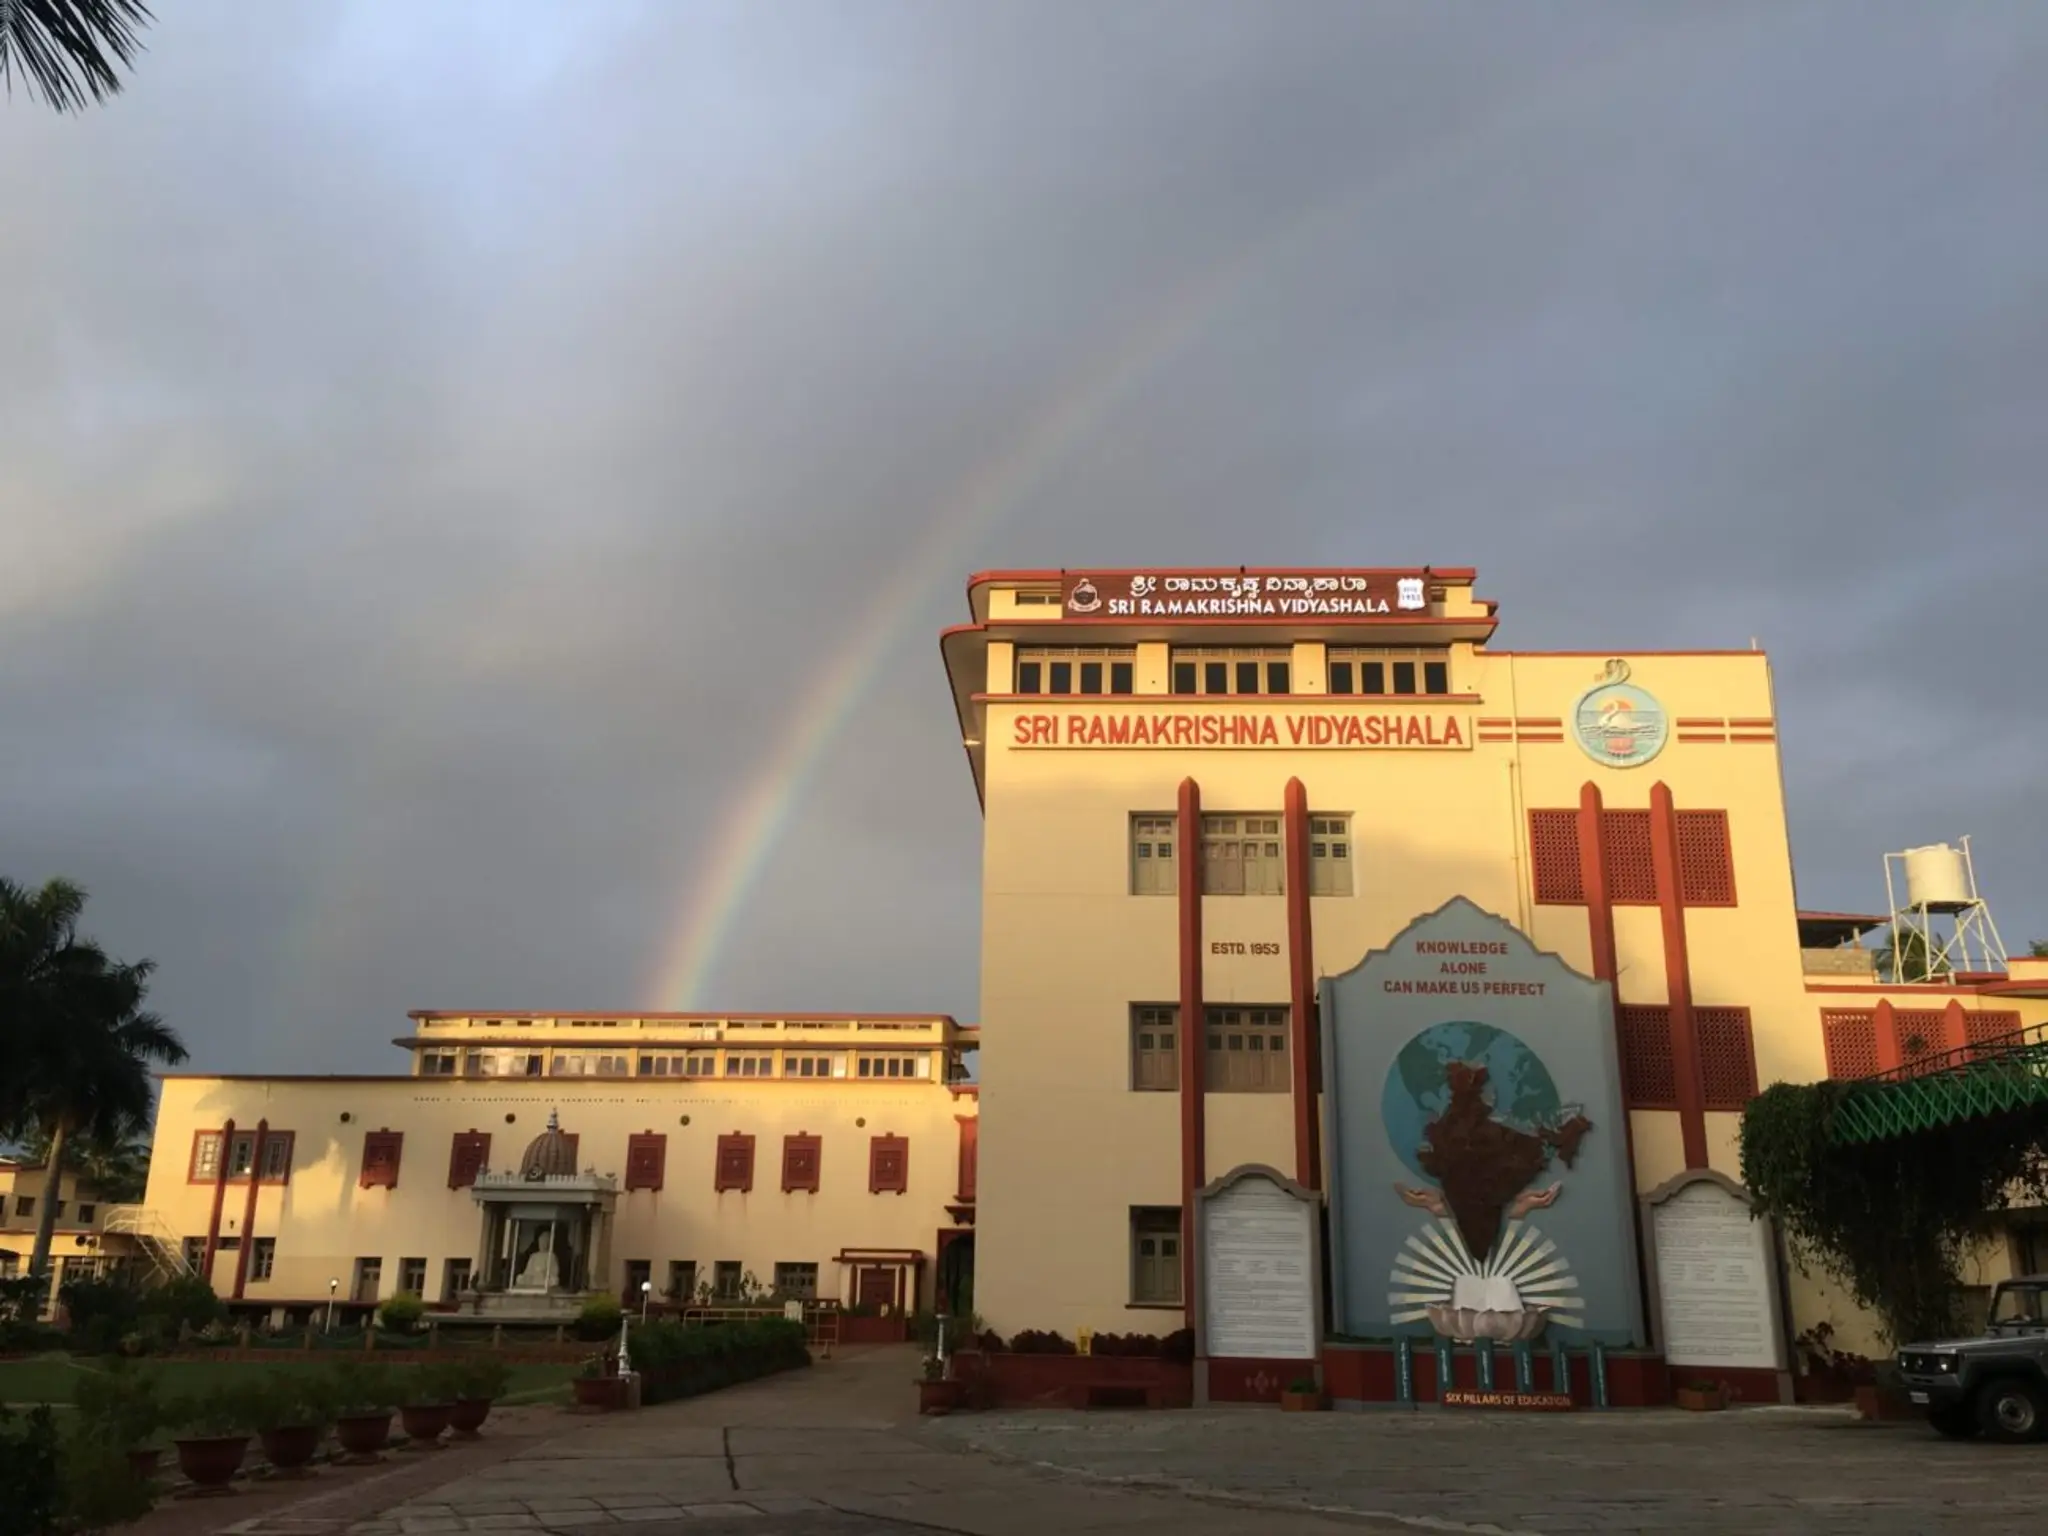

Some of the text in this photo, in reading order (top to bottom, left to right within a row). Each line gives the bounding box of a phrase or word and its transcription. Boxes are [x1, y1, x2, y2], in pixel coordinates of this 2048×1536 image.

[1130, 576, 1157, 597] ಶ್ರೀ
[1108, 599, 1135, 615] SRI
[1141, 598, 1275, 615] RAMAKRISHNA
[1280, 598, 1390, 614] VIDYASHALA
[1013, 715, 1463, 746] SRI RAMAKRISHNA VIDYASHALA
[1250, 943, 1280, 955] 1953
[1416, 940, 1508, 955] KNOWLEDGE
[1440, 962, 1487, 975] ALONE
[1384, 980, 1545, 996] CAN MAKE US PERFECT
[1445, 1392, 1462, 1404] SIX
[1463, 1393, 1501, 1405] PILLARS
[1504, 1394, 1516, 1406] OF
